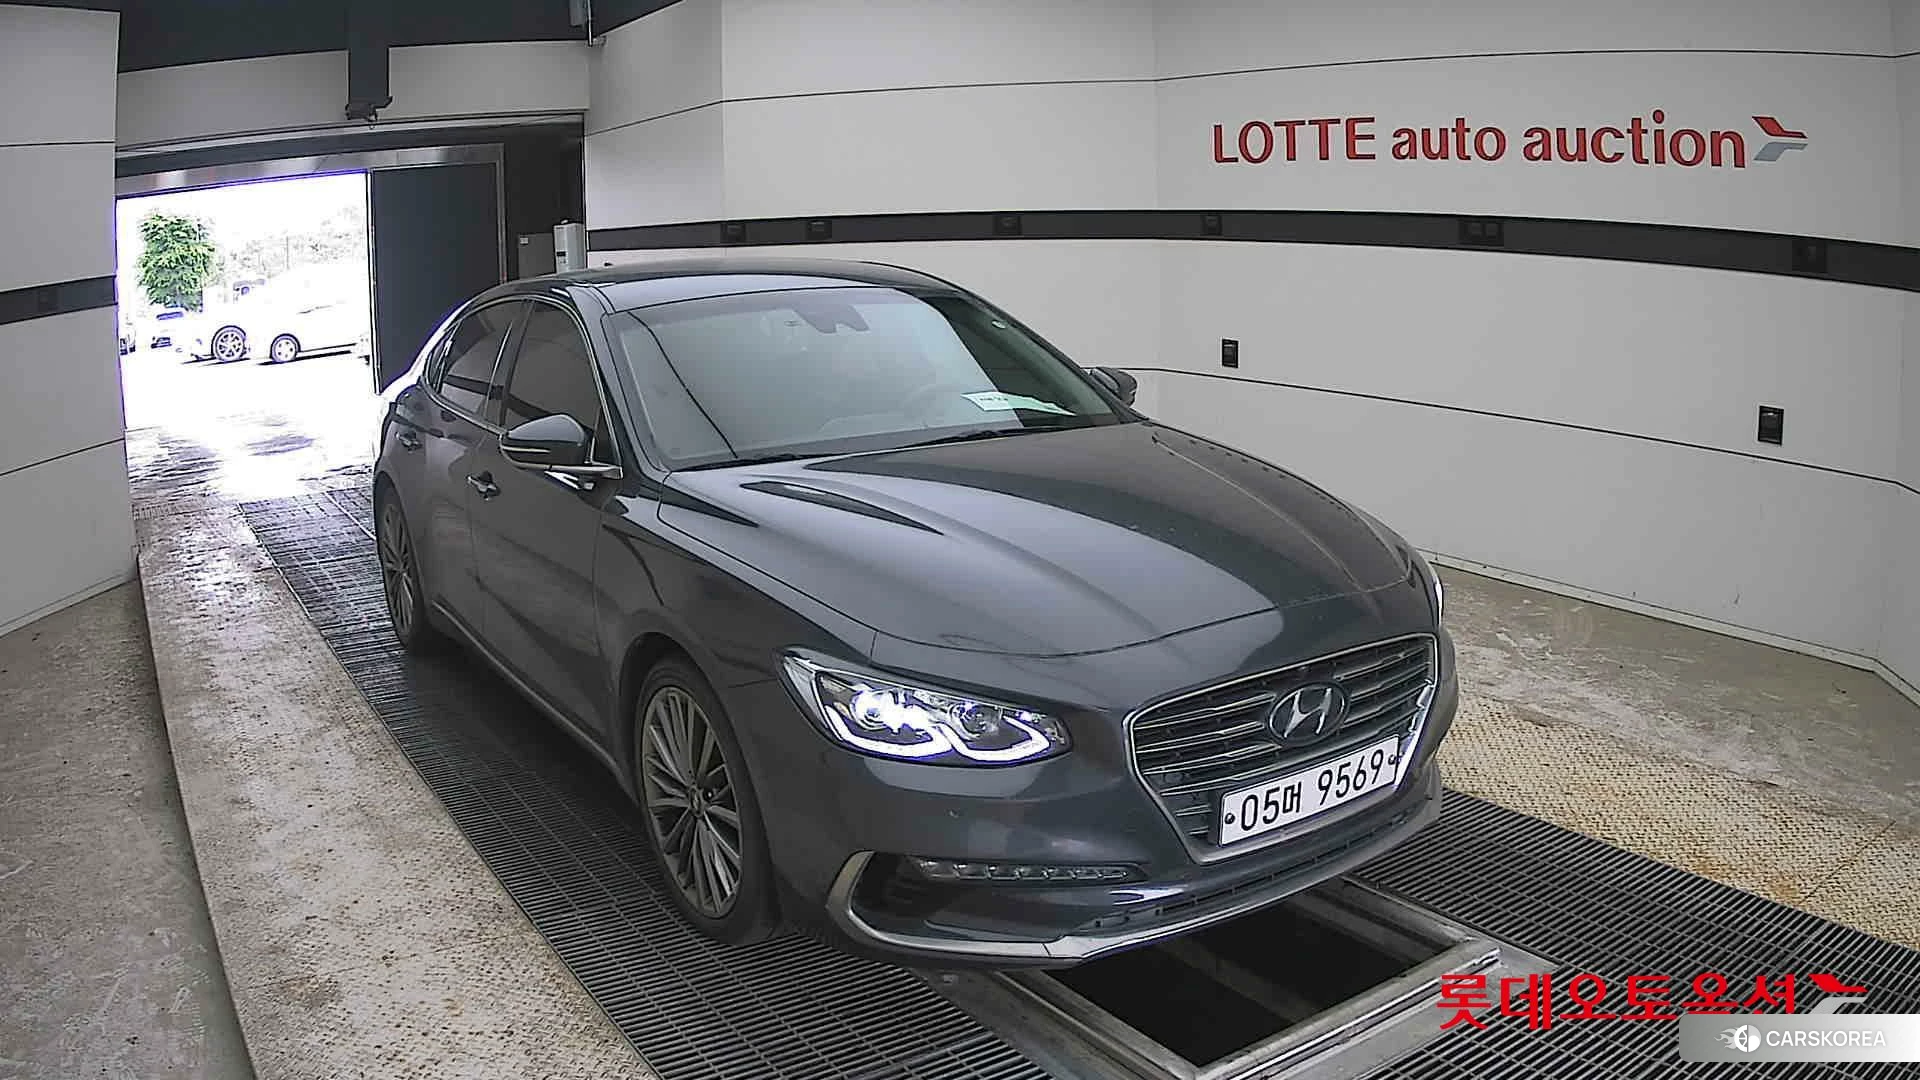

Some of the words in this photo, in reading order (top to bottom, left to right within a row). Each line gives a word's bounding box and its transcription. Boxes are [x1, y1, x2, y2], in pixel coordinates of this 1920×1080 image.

[1213, 117, 1376, 164] LOTTE
[1391, 116, 1507, 161] auto
[1522, 108, 1746, 169] auction
[1240, 780, 1303, 832] 05머
[1317, 748, 1385, 807] 9569
